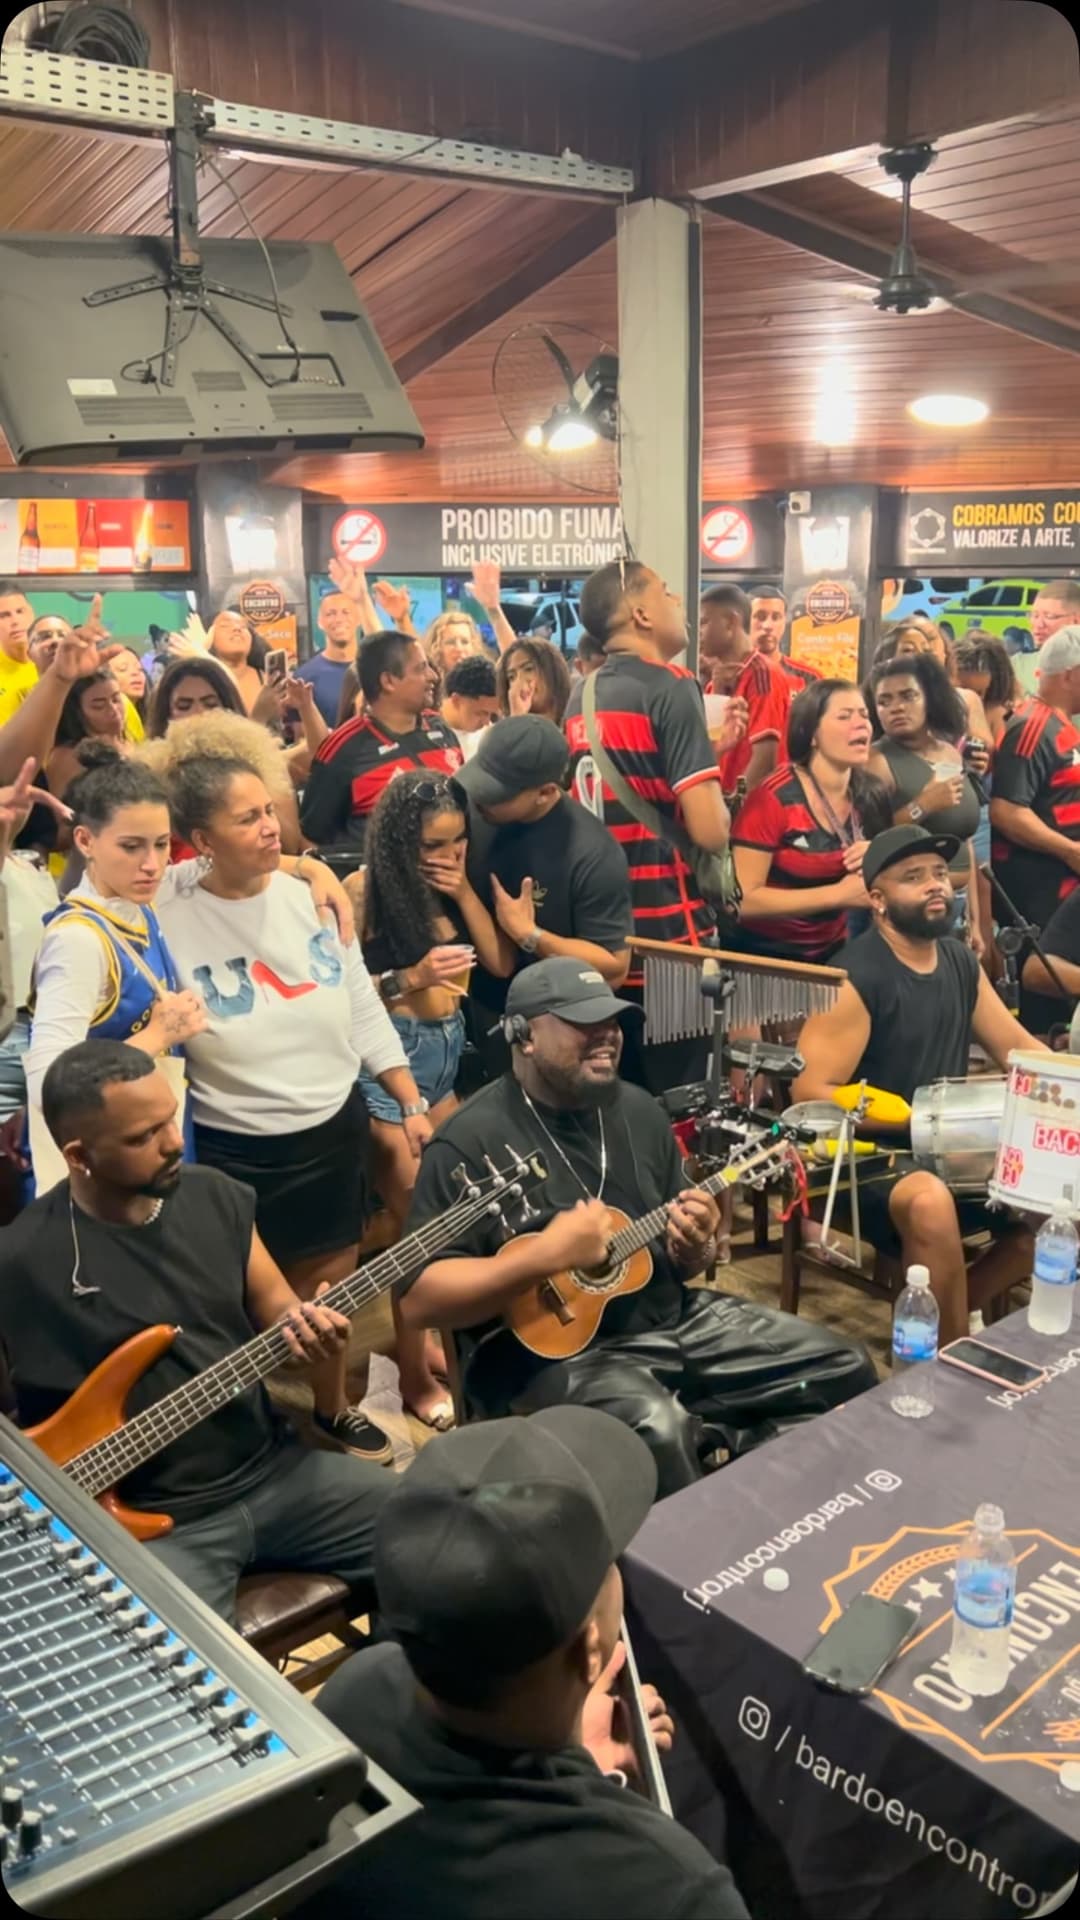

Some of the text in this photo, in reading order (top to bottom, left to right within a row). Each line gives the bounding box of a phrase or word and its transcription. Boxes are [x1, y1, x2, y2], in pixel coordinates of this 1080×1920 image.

[441, 508, 553, 540] PROIBIDO
[953, 503, 1045, 526] COBRAMOS
[953, 528, 1075, 548] VALORIZE A ARTE,
[442, 544, 528, 567] INCLUSIVE
